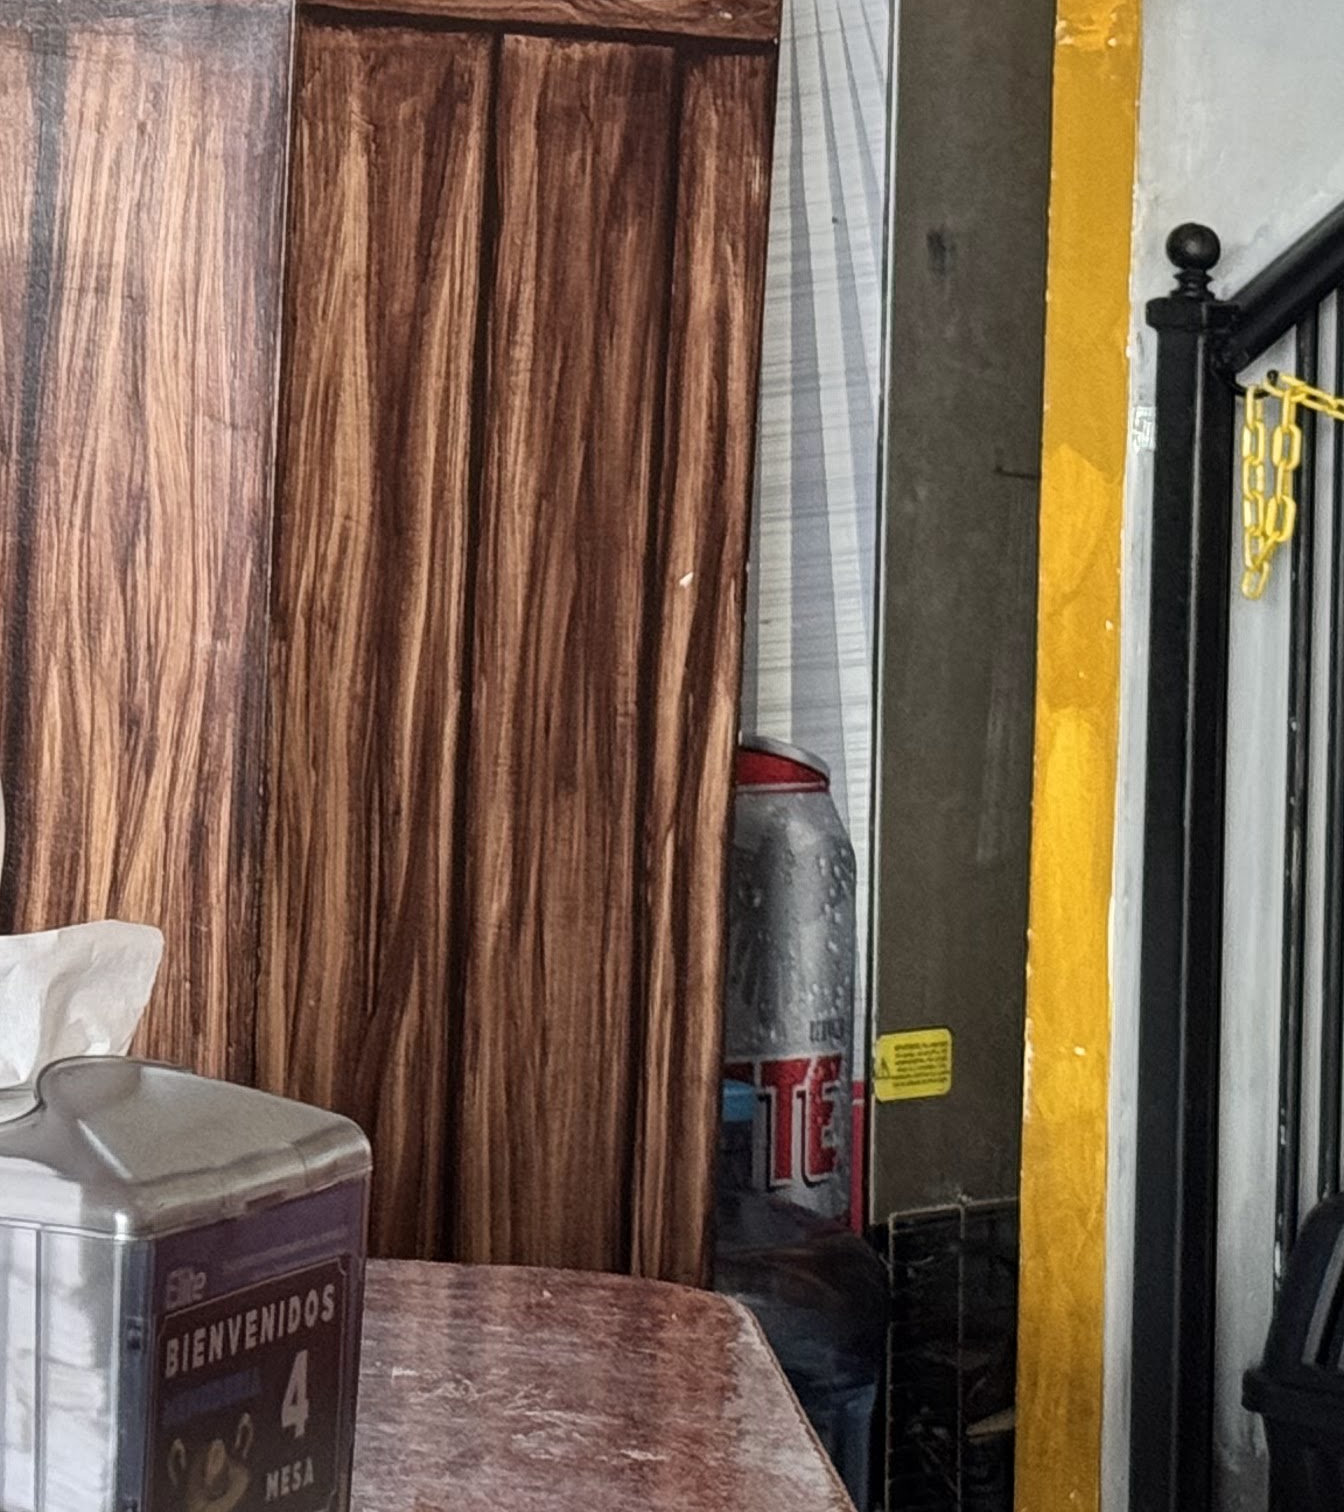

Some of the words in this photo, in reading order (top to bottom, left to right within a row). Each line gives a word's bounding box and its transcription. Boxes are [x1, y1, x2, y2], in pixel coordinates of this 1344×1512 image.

[165, 1284, 336, 1380] BIENVENIDOS
[280, 1349, 310, 1440] 4
[265, 1455, 315, 1503] MESA
